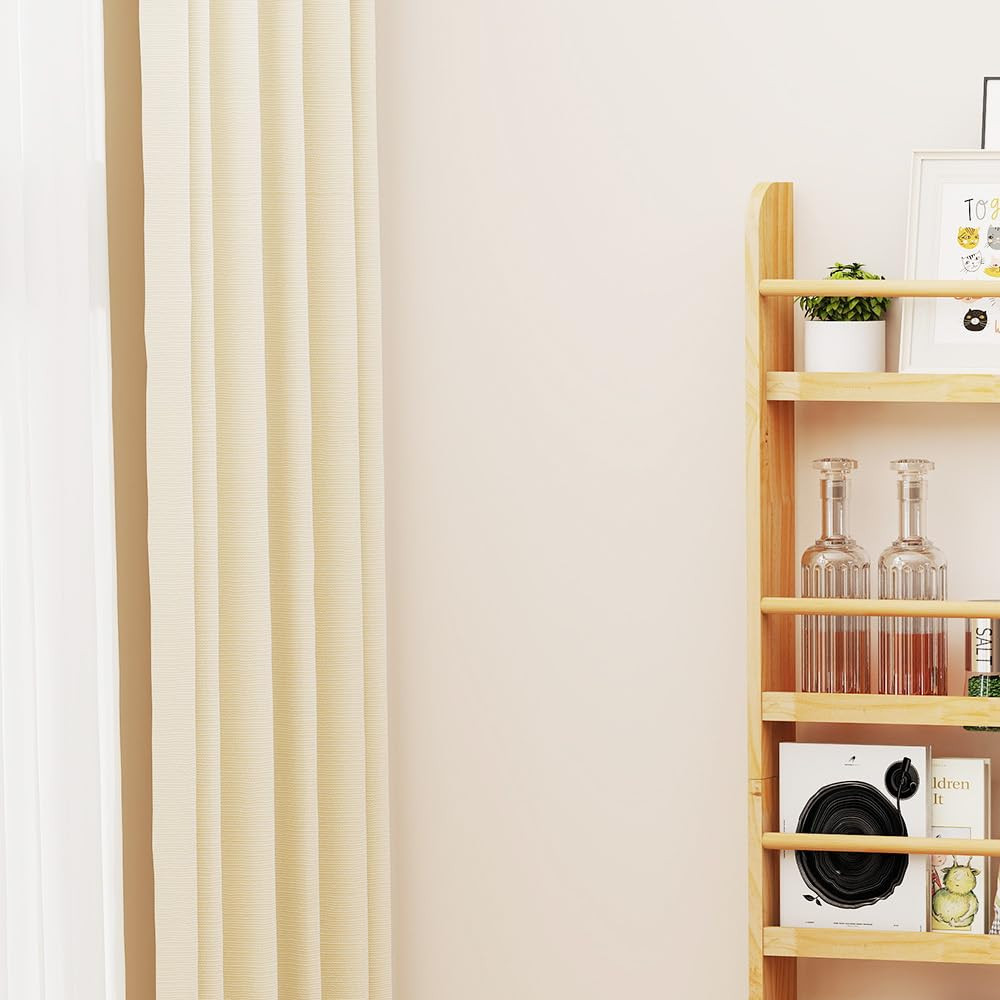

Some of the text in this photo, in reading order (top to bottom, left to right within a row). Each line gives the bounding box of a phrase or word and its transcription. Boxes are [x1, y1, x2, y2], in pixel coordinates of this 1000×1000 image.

[975, 627, 993, 666] SALT
[933, 776, 970, 790] ldren
[934, 793, 944, 805] It
